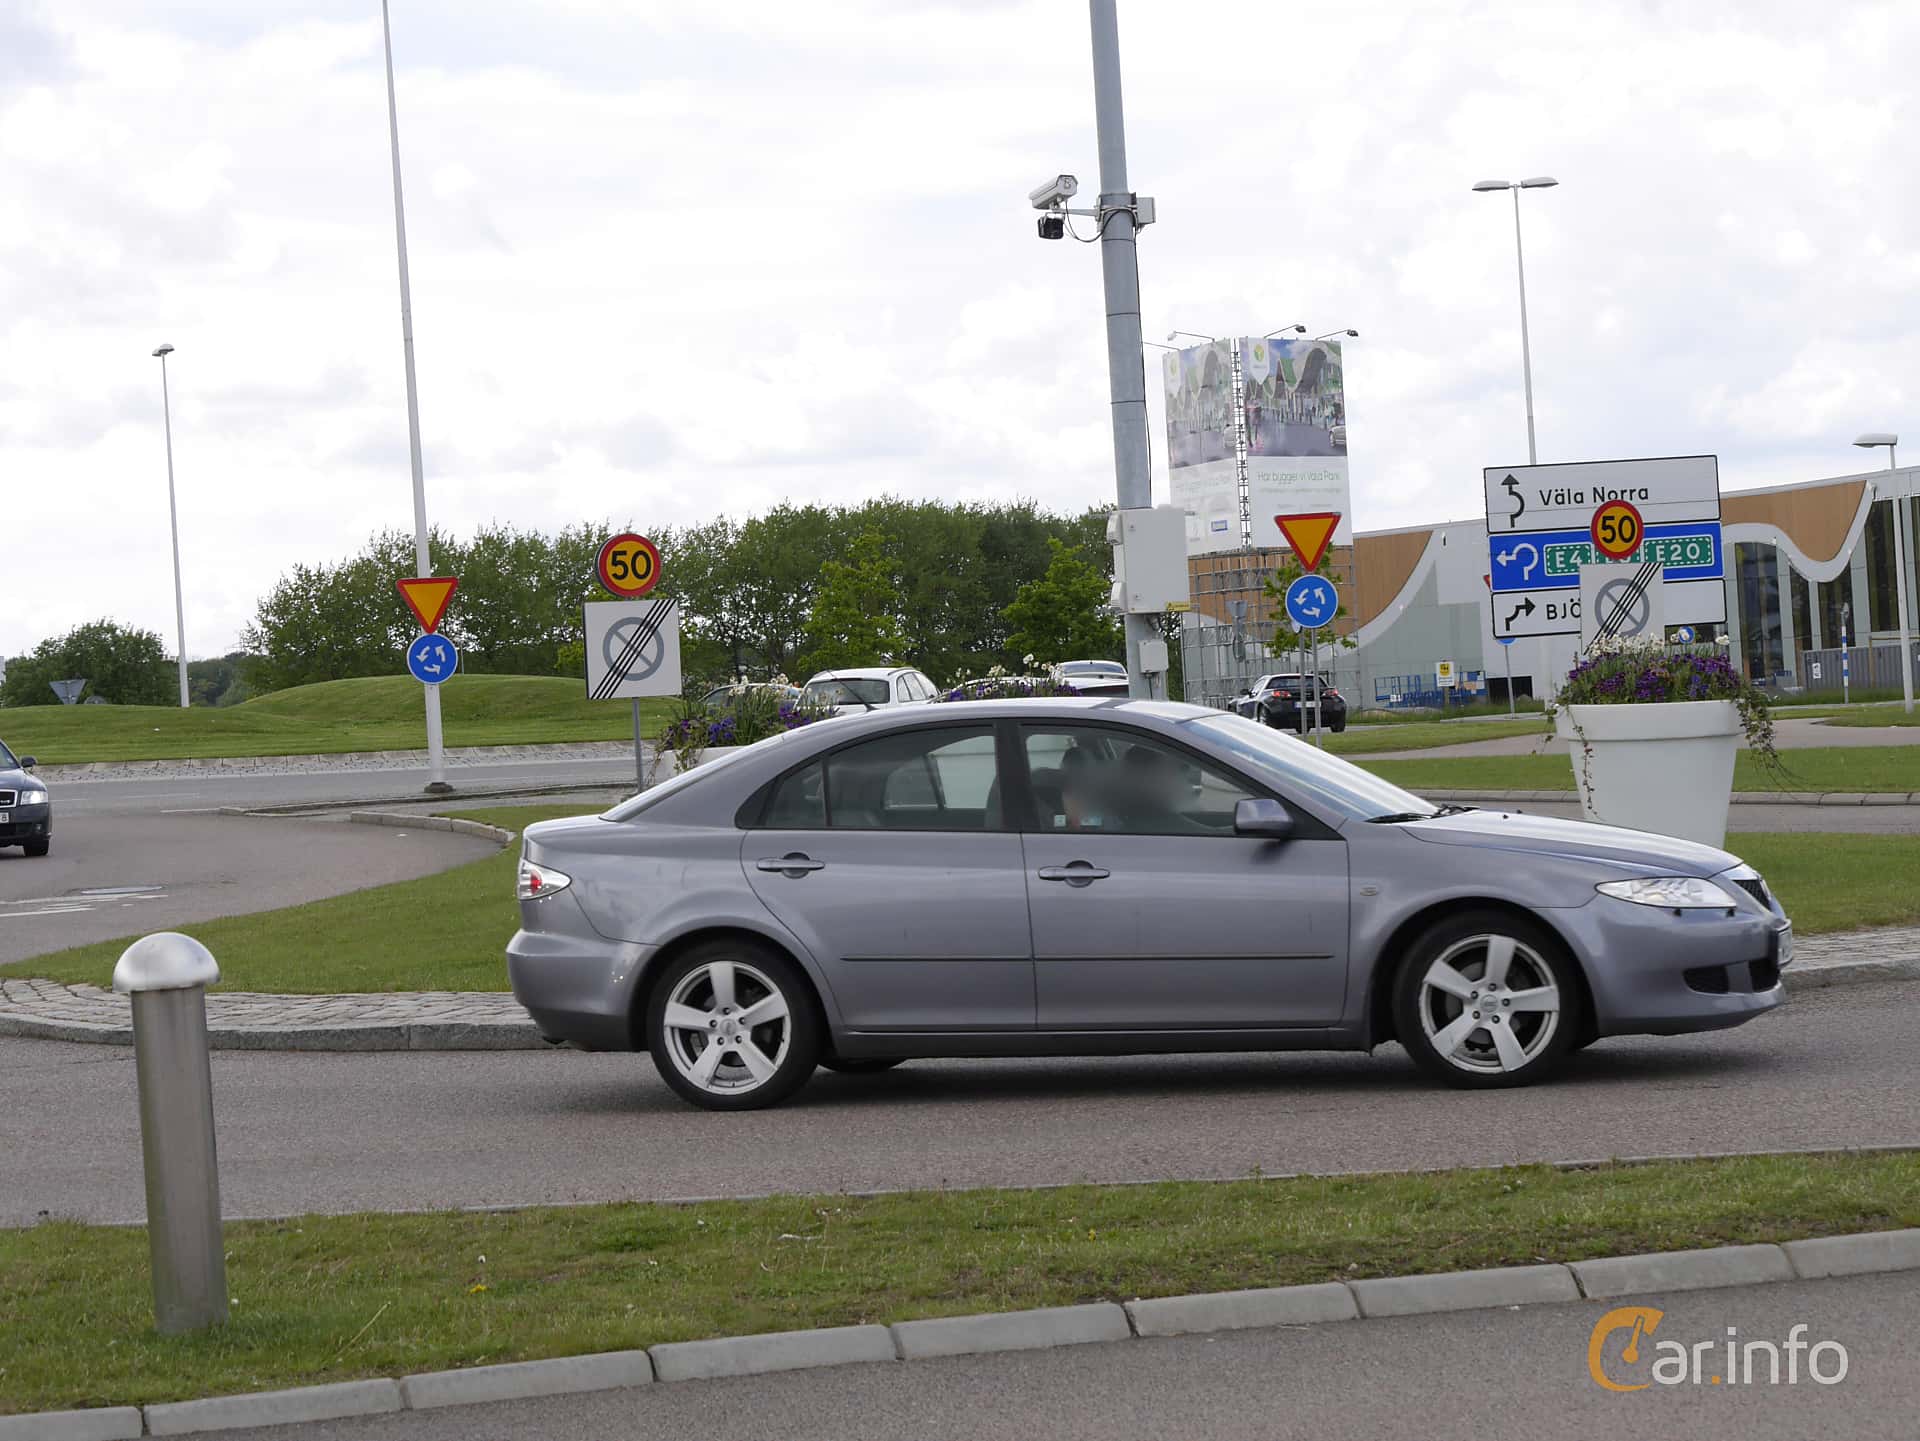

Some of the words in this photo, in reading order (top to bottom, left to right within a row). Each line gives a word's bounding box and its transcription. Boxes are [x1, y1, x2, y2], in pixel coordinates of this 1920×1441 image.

[1540, 488, 1584, 506] Väla
[1593, 486, 1649, 502] Norra
[1600, 515, 1636, 544] 50
[1555, 550, 1582, 569] E4
[1655, 543, 1701, 562] E20
[611, 550, 652, 580] 50
